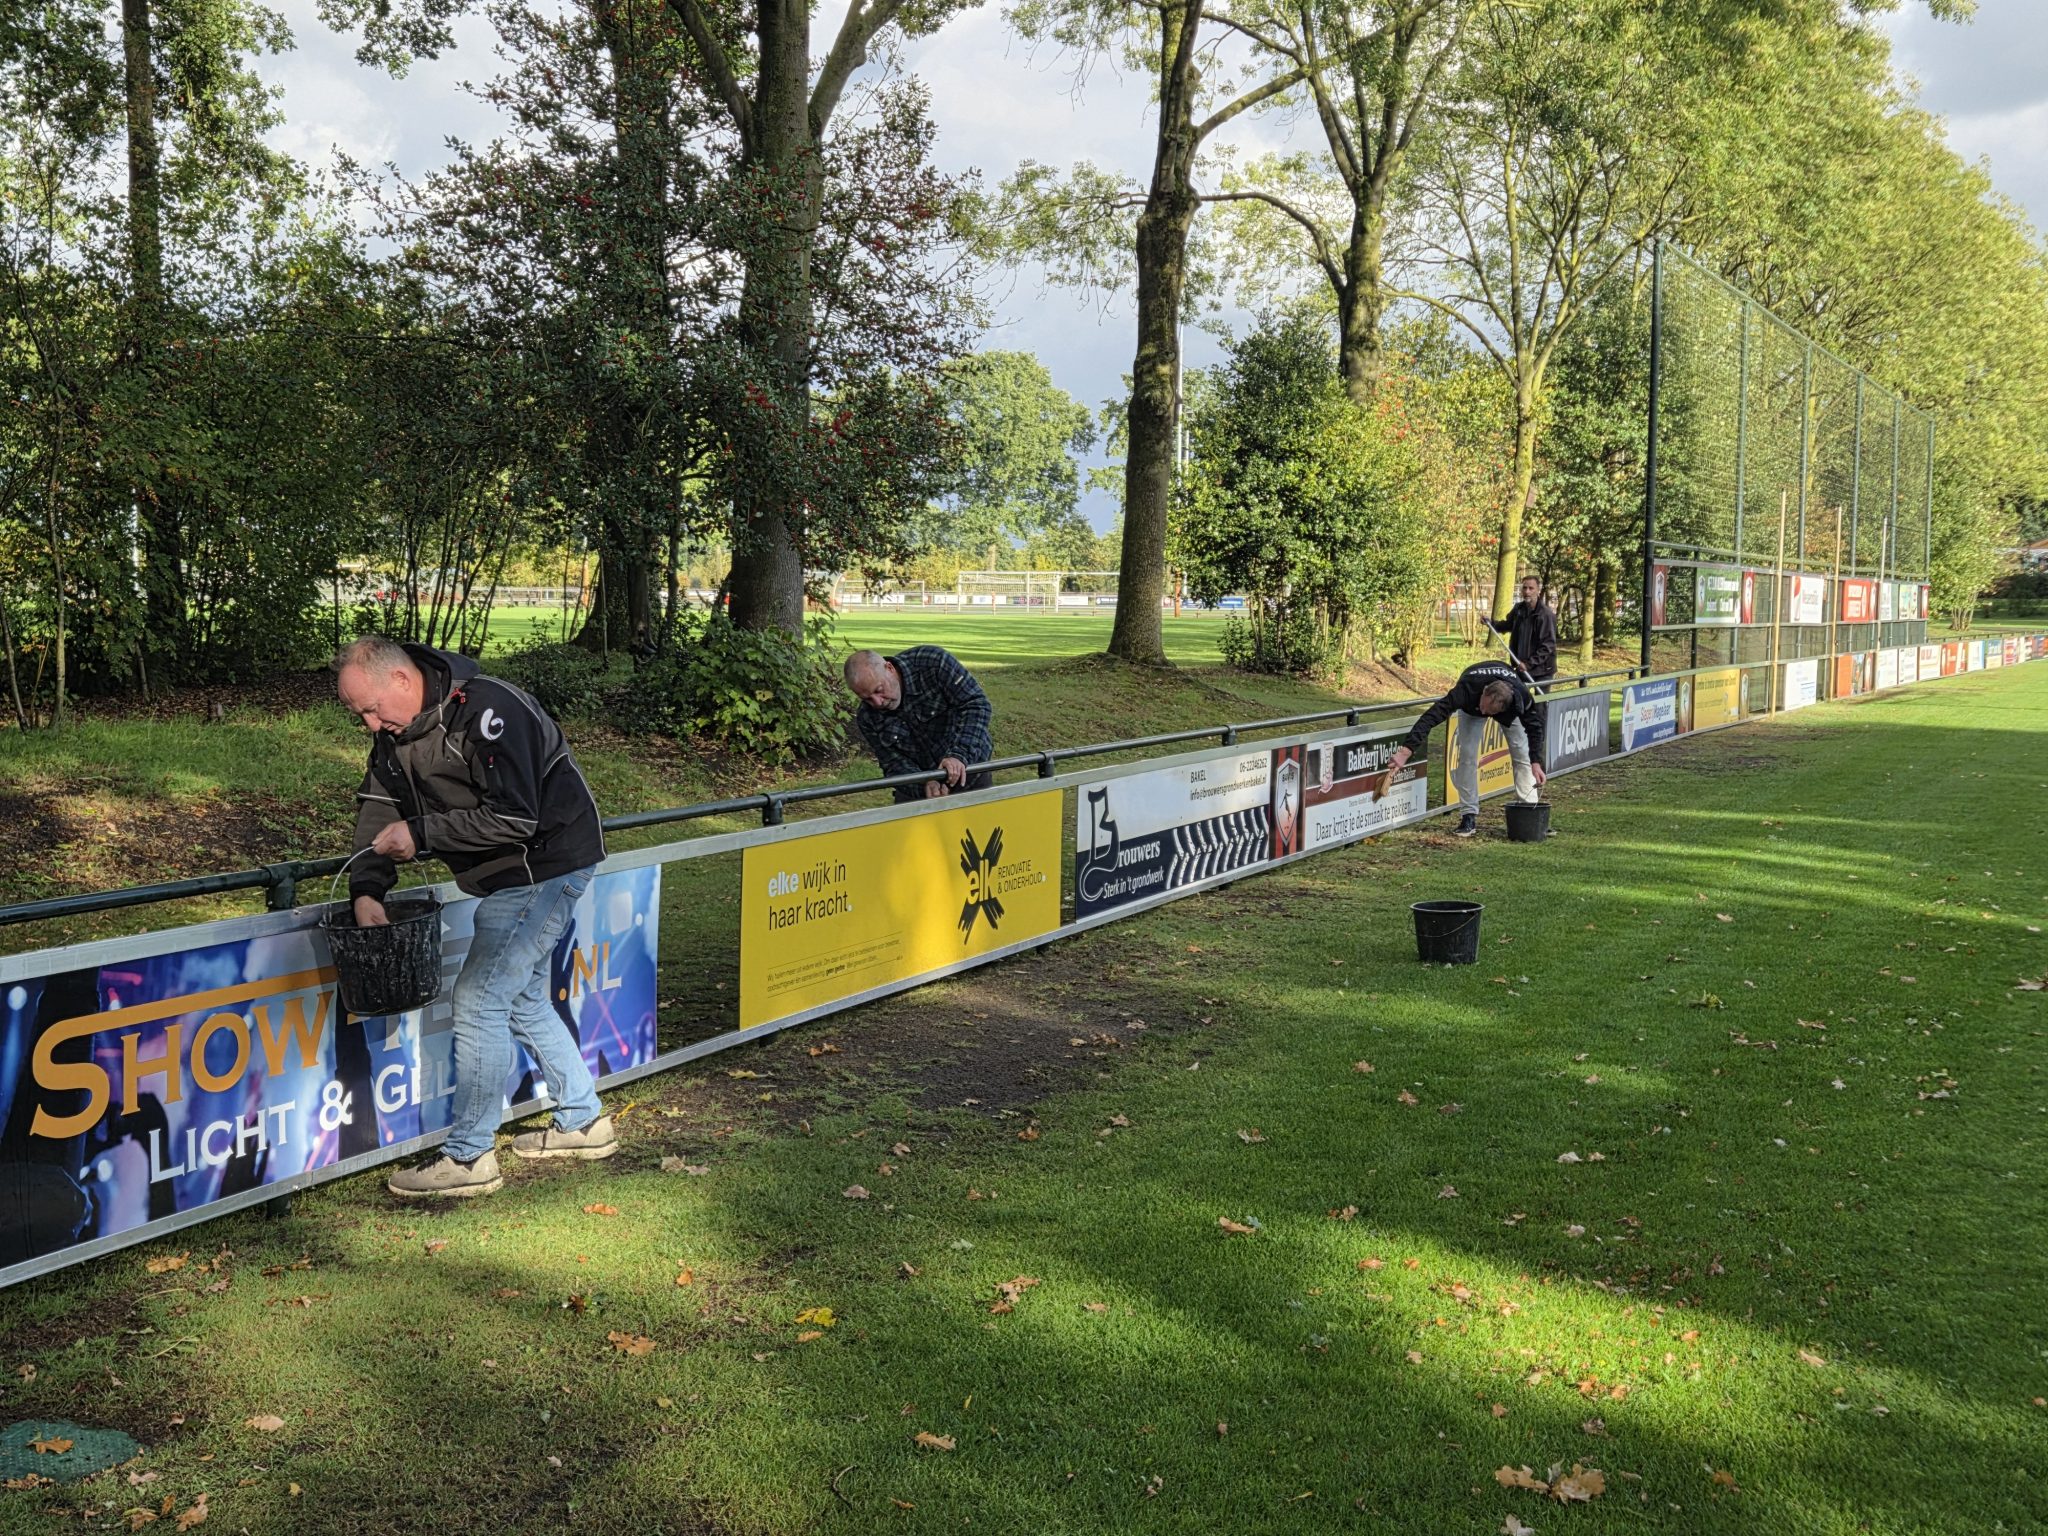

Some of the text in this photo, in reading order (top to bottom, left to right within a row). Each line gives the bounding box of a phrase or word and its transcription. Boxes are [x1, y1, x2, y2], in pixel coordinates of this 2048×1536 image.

[1559, 705, 1599, 757] VESCOM
[1348, 744, 1379, 772] Bakkerij
[1190, 769, 1207, 783] BAKEL
[1315, 822, 1333, 842] Daar
[1333, 814, 1348, 838] krijg
[1348, 812, 1356, 836] je
[1356, 810, 1364, 829] de
[1364, 804, 1383, 827] smaak
[1384, 805, 1390, 821] te
[768, 858, 847, 898] elke wijk in
[998, 858, 1032, 879] RENOVATIE
[1103, 879, 1119, 899] Sterk
[1120, 877, 1127, 894] in
[1132, 865, 1164, 894] grondwerk
[997, 881, 1003, 895] &
[769, 905, 802, 932] haar
[148, 1099, 297, 1185] LICHT
[319, 1080, 353, 1132] &
